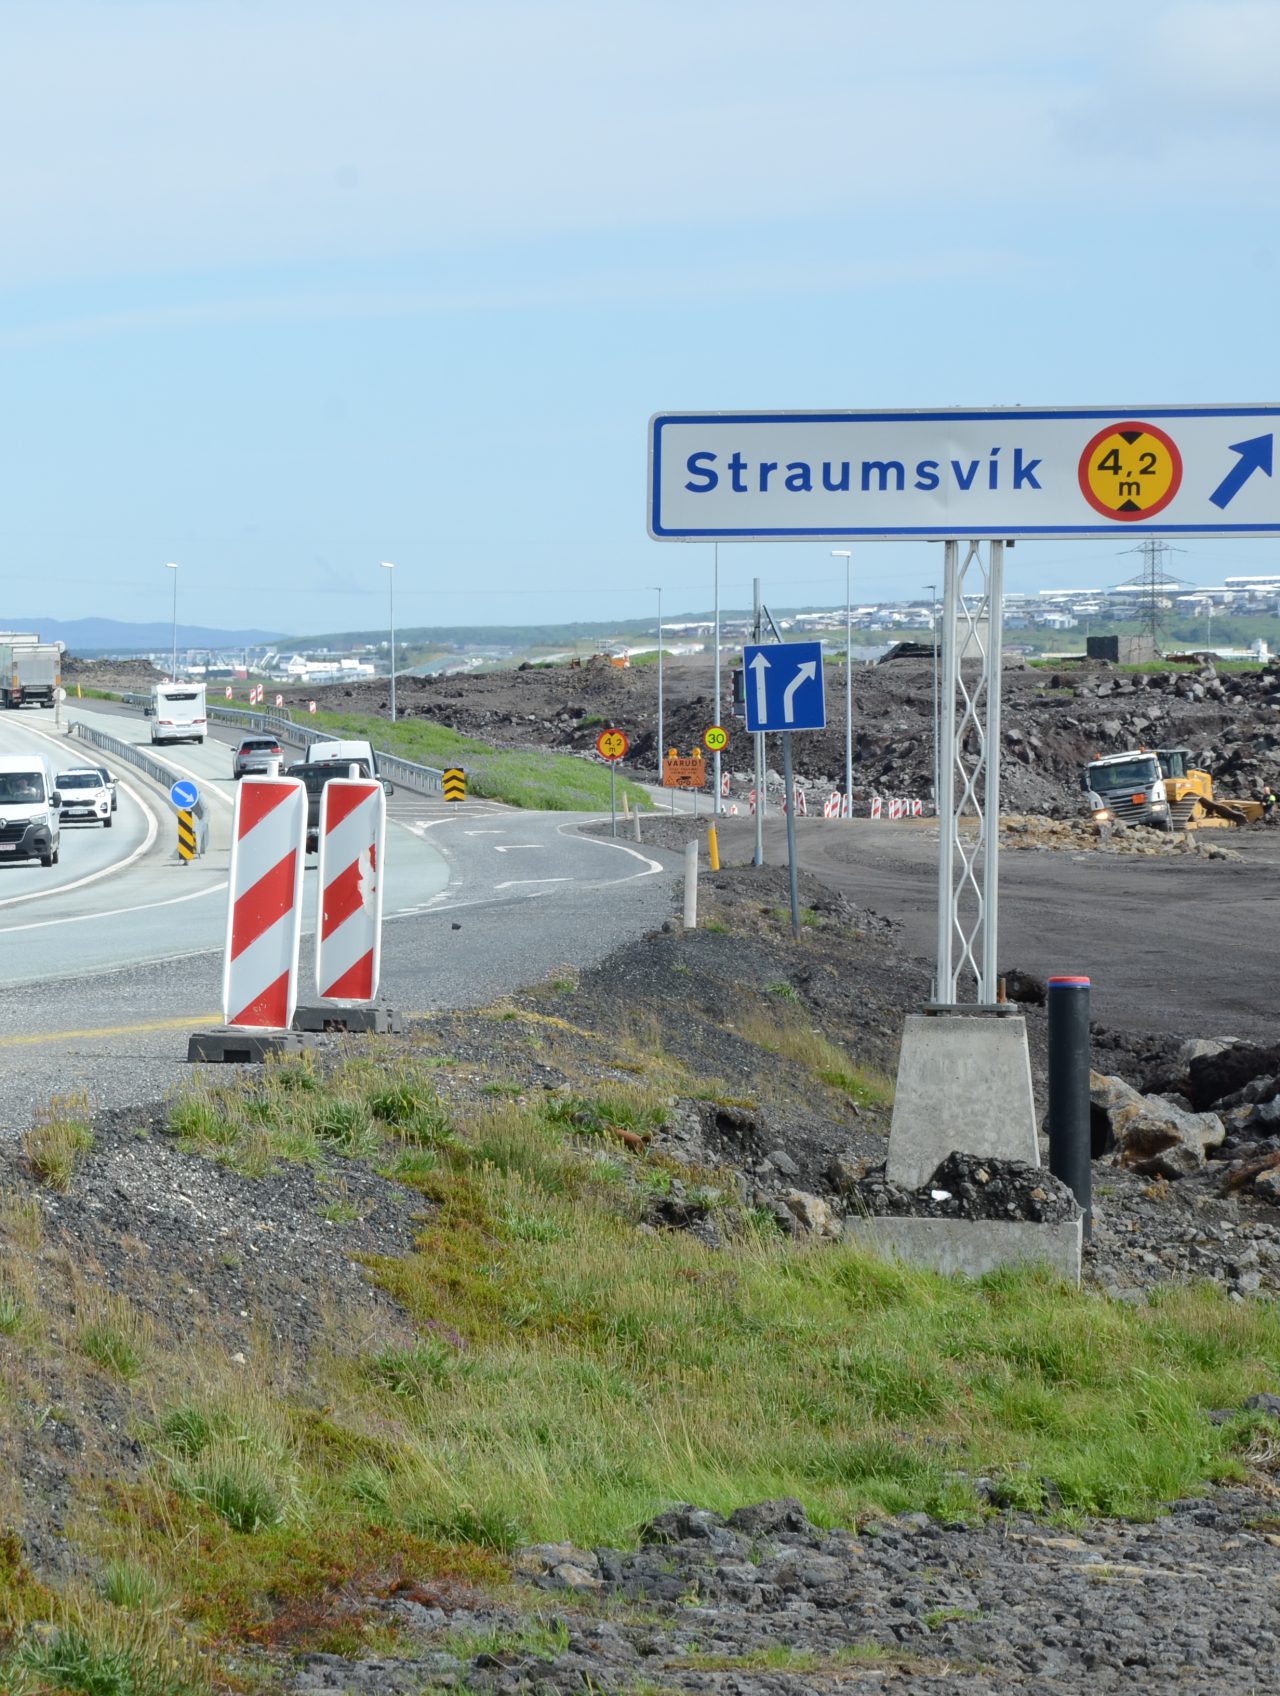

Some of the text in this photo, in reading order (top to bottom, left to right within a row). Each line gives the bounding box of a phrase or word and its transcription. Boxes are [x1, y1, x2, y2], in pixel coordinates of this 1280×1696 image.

[684, 447, 1043, 493] Straumsvík
[1097, 449, 1157, 478] 4,2
[1119, 481, 1141, 496] m
[708, 733, 725, 744] 30
